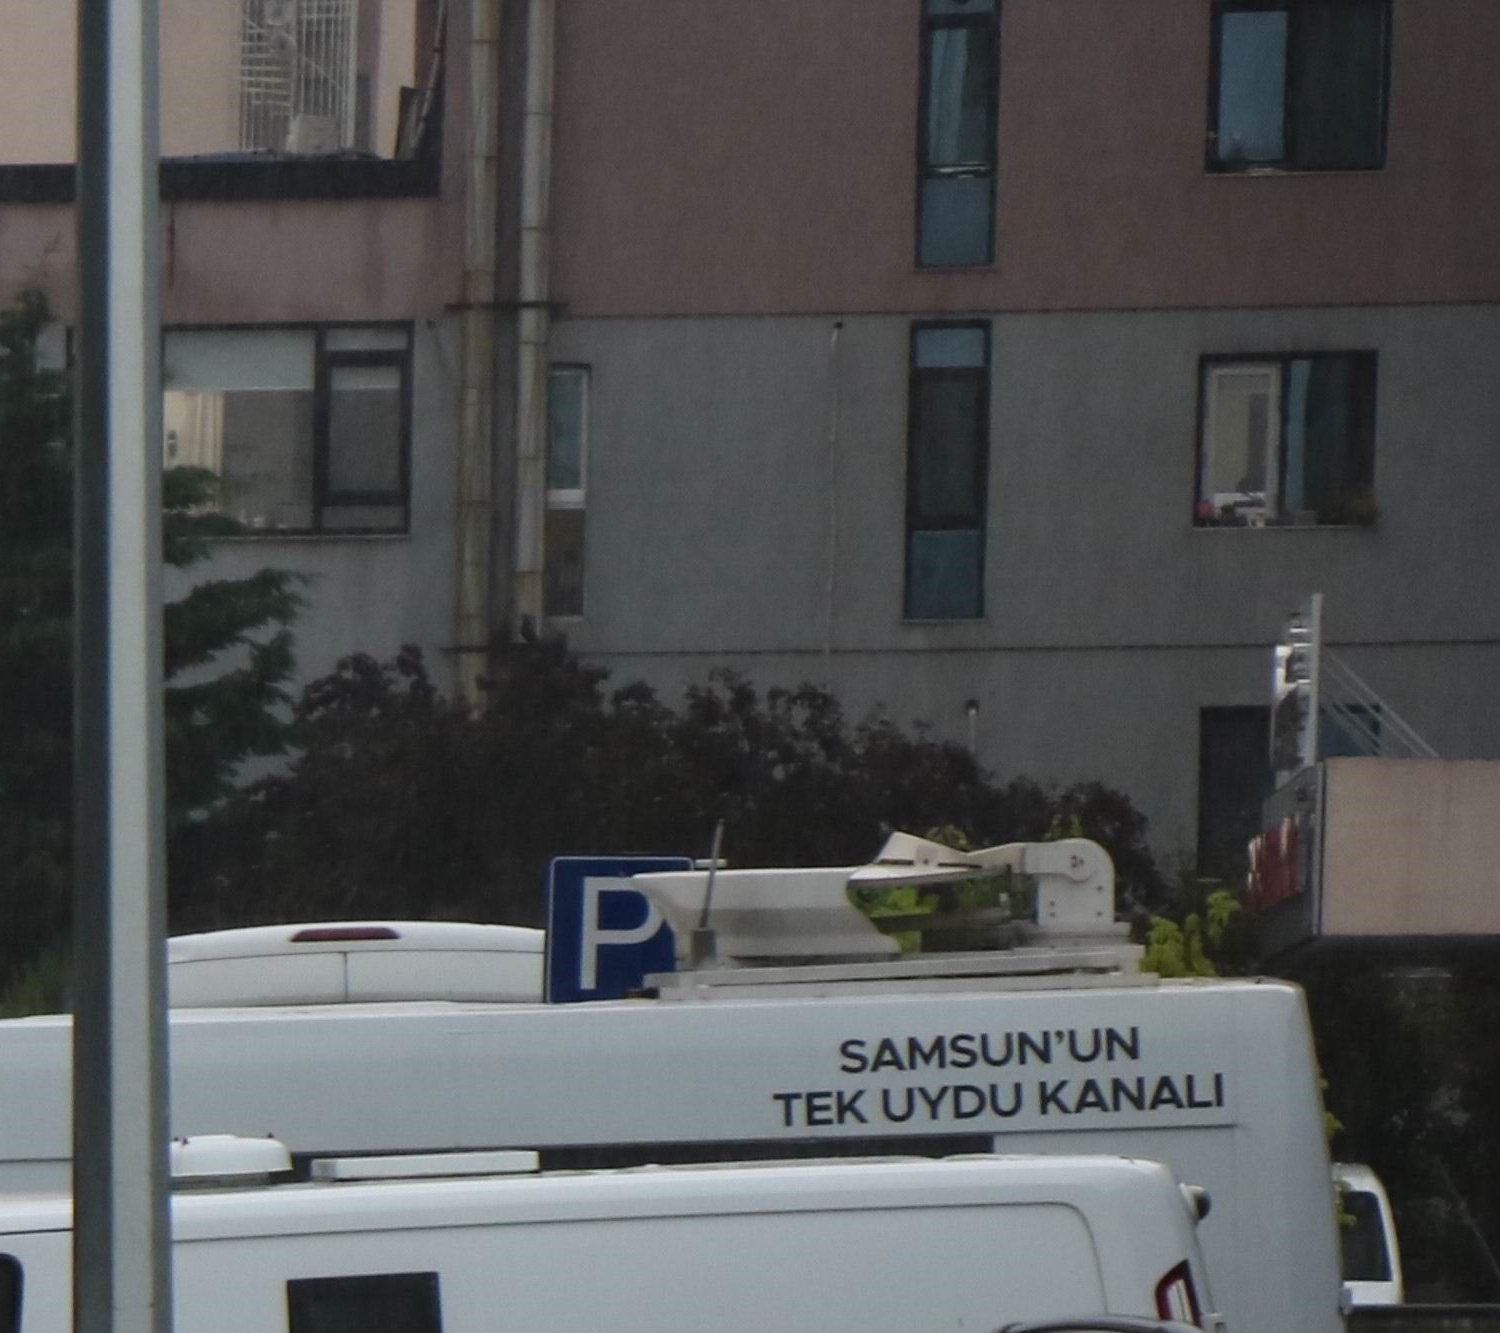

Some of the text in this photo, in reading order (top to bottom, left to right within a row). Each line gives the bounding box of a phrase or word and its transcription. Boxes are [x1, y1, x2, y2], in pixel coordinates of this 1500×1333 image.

[580, 876, 665, 990] P
[840, 1026, 1142, 1074] SAMSUN'UN
[772, 1072, 1226, 1128] TEK UYDU KANALI
